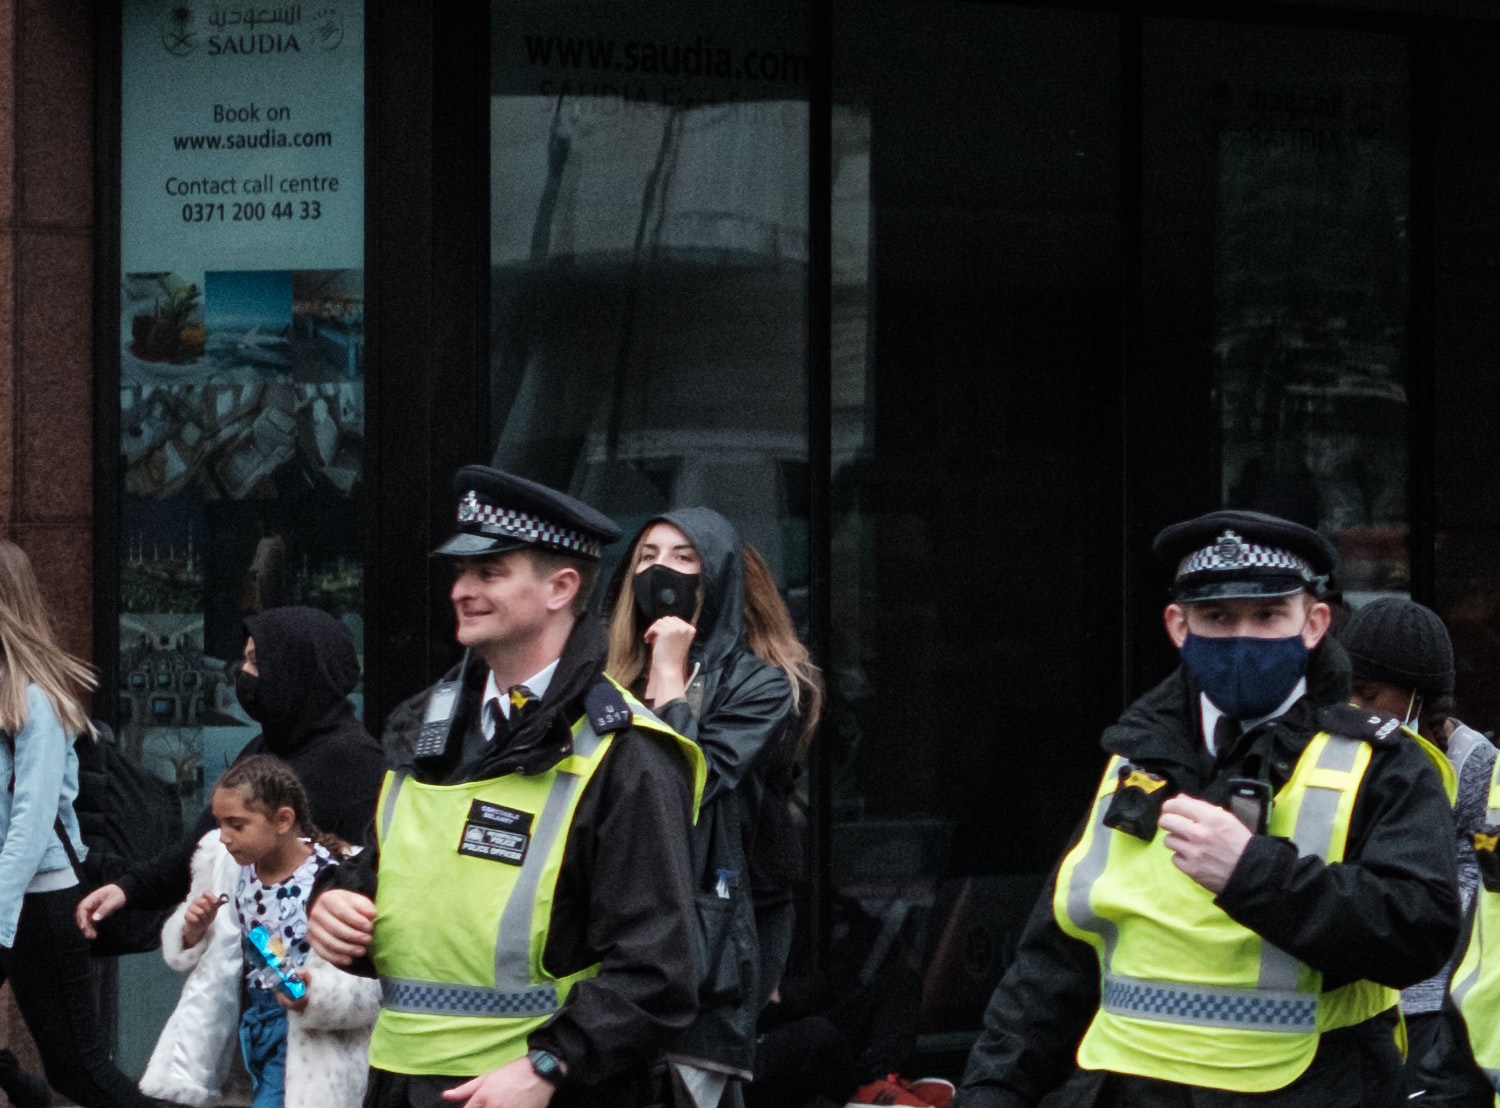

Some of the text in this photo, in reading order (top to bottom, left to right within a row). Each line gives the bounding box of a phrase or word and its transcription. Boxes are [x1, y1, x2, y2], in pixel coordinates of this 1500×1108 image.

[207, 34, 301, 56] SAUDIA
[524, 35, 809, 82] www.saudia.com
[213, 103, 291, 123] Book on
[173, 129, 332, 151] www.saudia.com
[165, 174, 339, 197] Contact call centre
[182, 201, 322, 222] 0371 200 44 33
